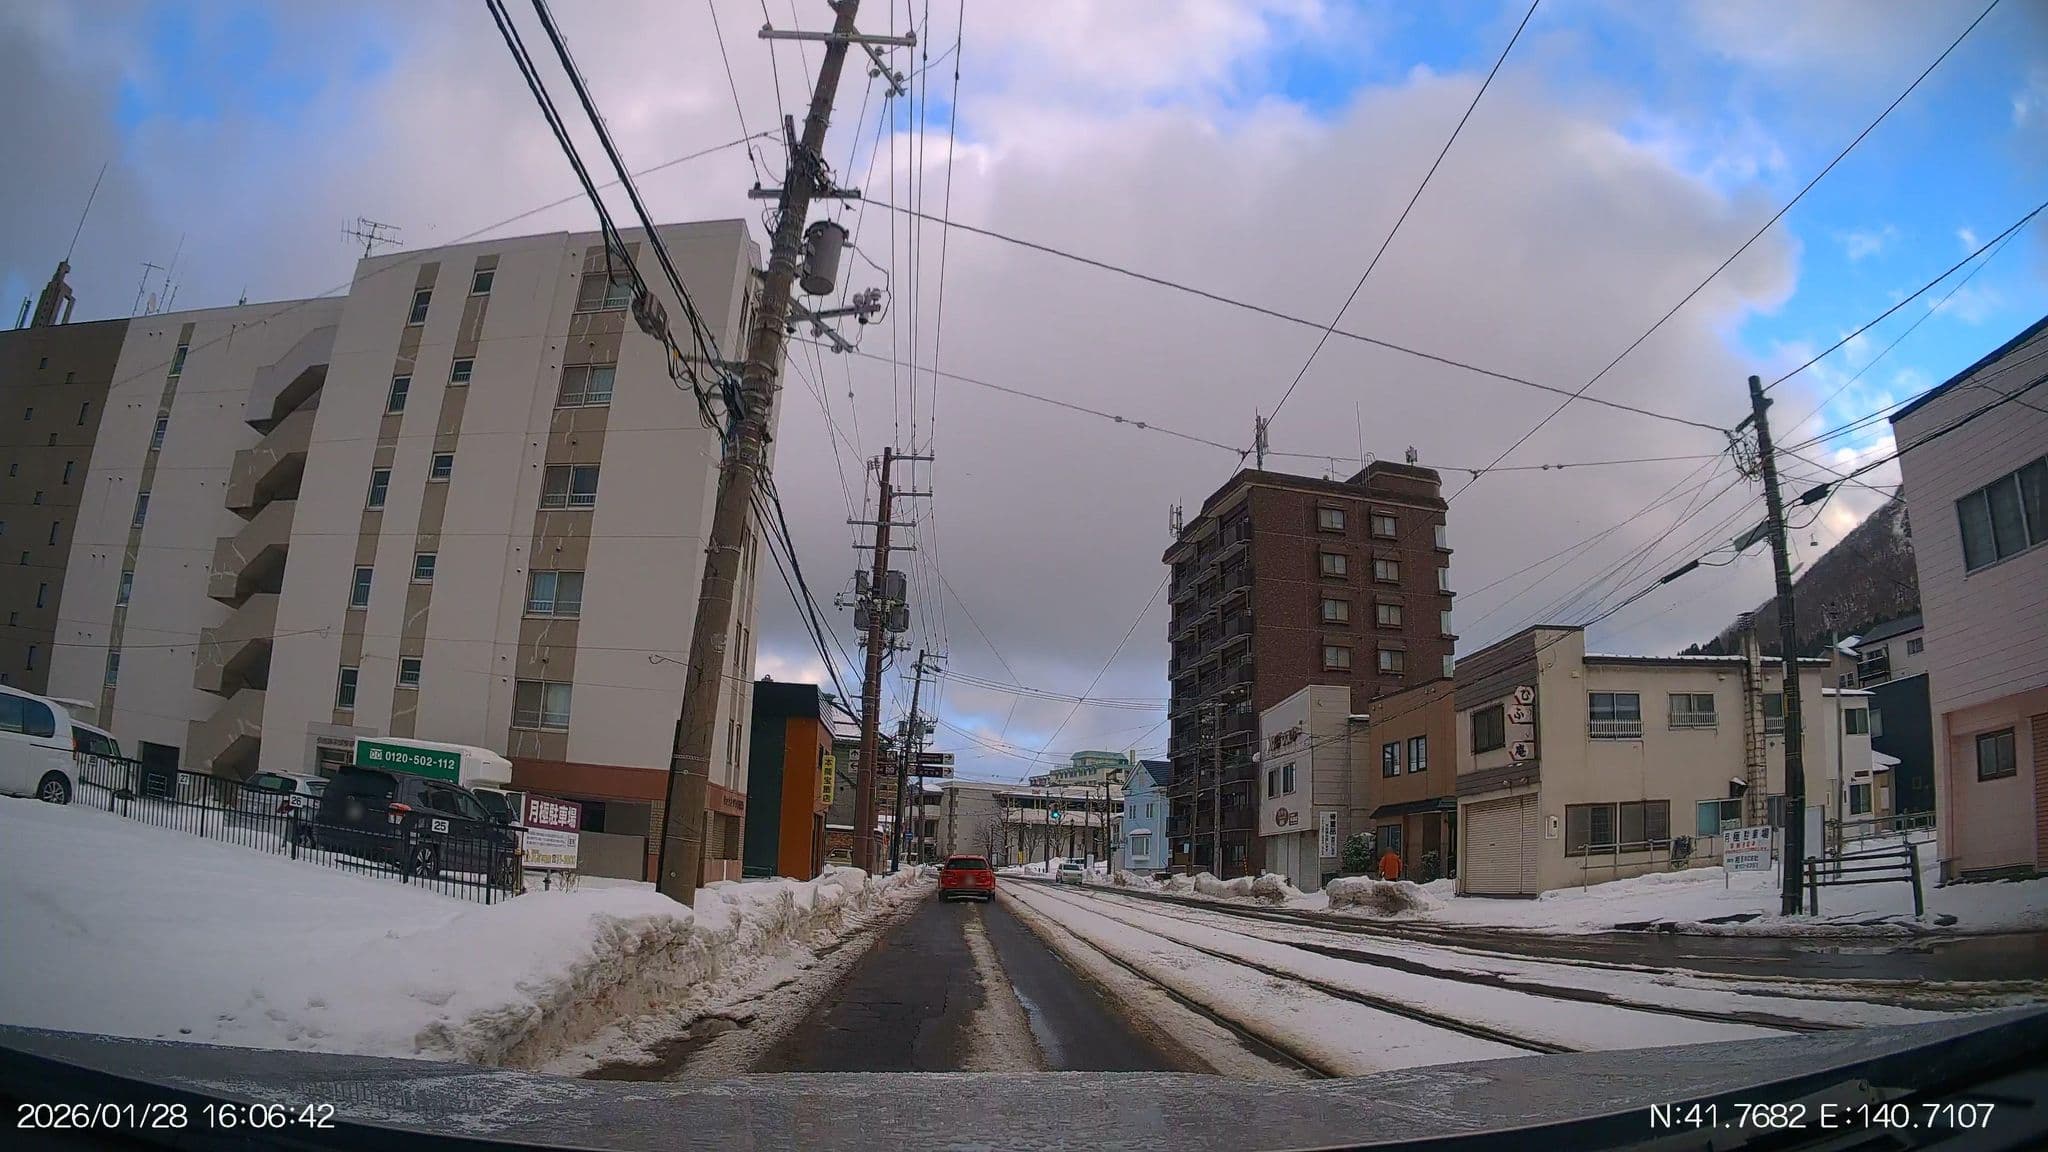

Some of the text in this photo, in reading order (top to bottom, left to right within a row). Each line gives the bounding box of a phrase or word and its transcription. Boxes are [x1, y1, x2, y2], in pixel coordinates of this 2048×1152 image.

[385, 751, 455, 770] 0120-502-112
[180, 774, 189, 784] 27
[291, 796, 302, 806] 26
[528, 800, 577, 829] 月極駐車場
[434, 820, 447, 832] 25
